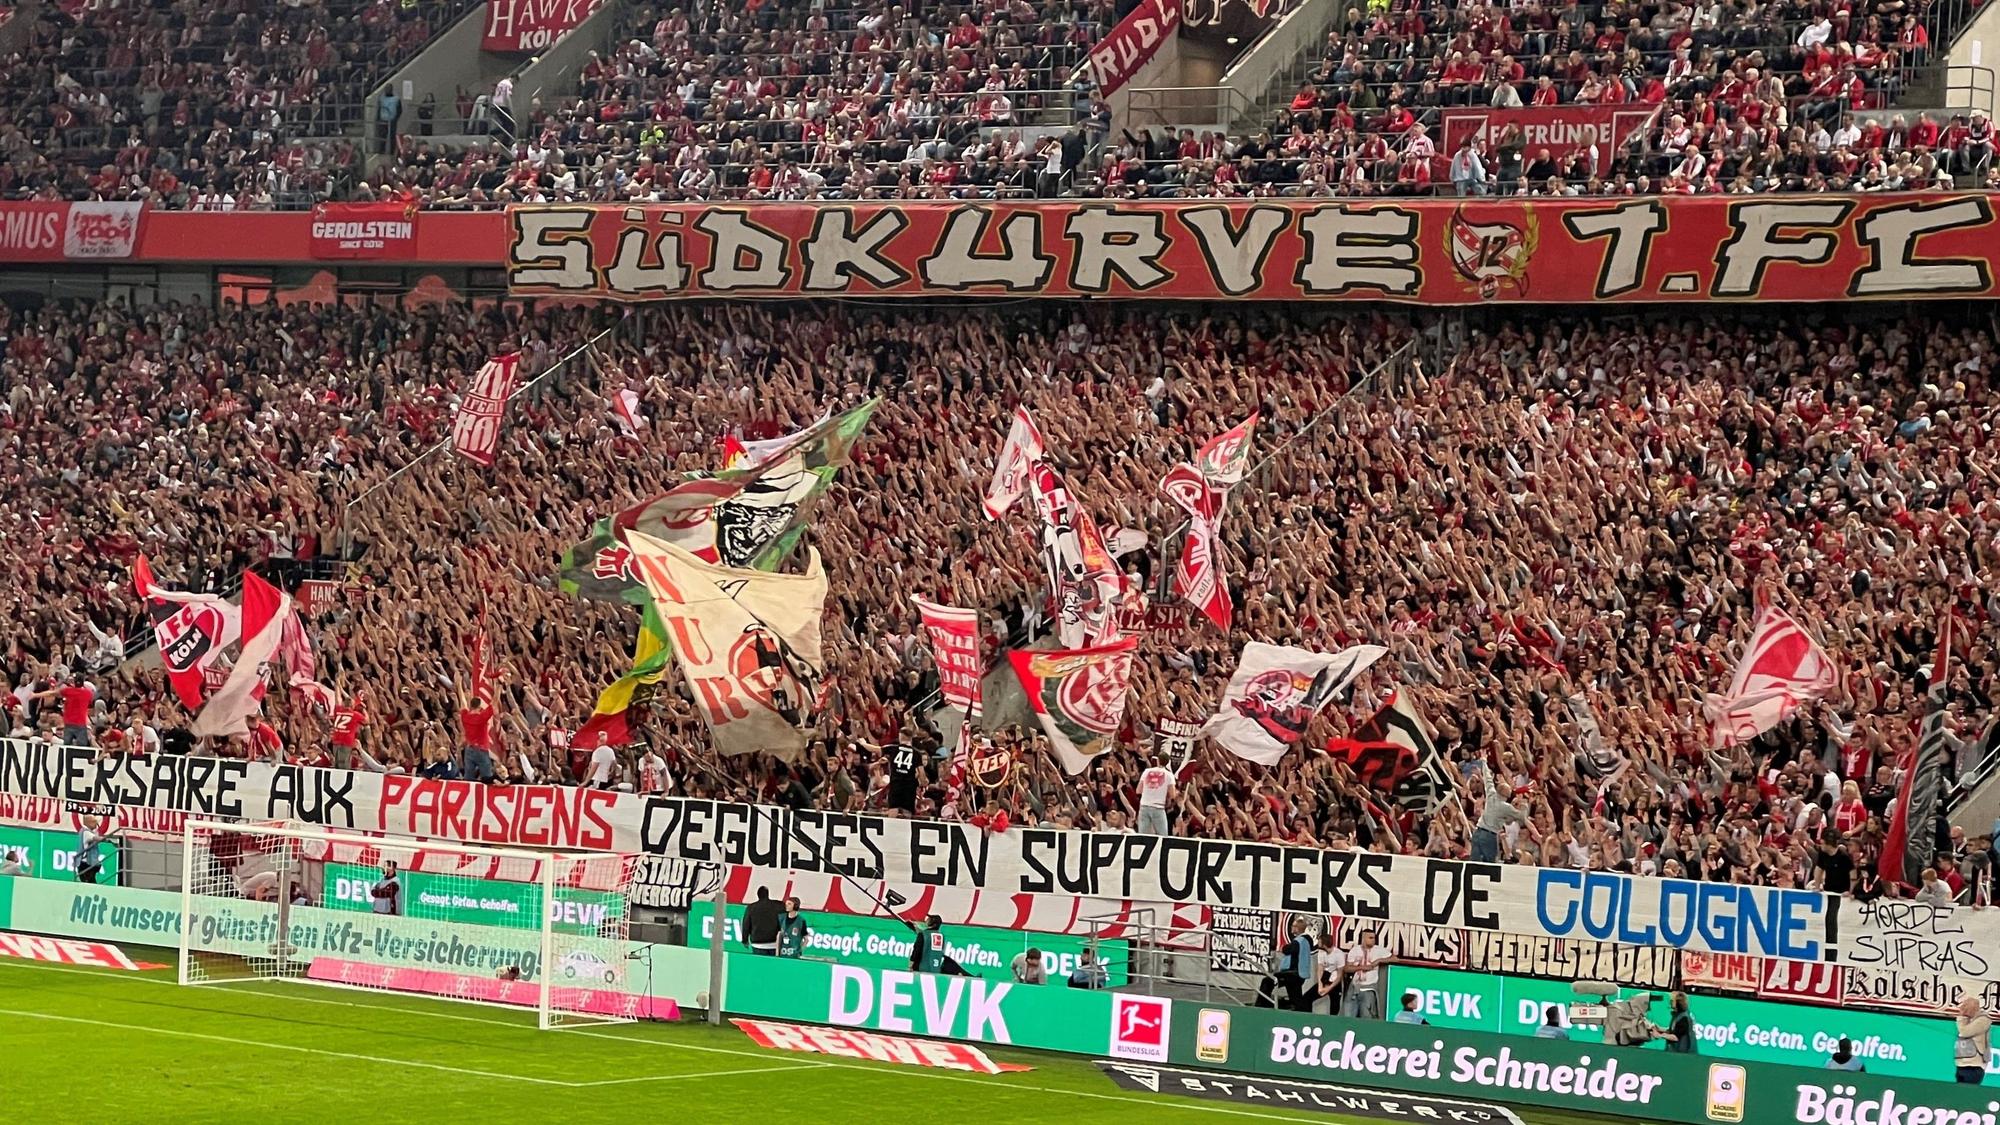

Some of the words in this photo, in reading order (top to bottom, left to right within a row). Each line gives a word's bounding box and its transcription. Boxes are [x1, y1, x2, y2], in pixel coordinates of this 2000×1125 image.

[0, 211, 59, 249] MUS
[312, 221, 412, 239] GEROLSTEIN
[512, 203, 1421, 297] SÜDKURVE
[1478, 235, 1508, 267] 12
[169, 618, 202, 666] KÖLN
[334, 714, 352, 729] 12
[894, 751, 913, 770] 44
[0, 792, 67, 824] STADT
[267, 766, 353, 829] AUX
[378, 773, 618, 850] PARISIENS
[641, 797, 884, 880] DEGUISES
[910, 820, 989, 888] EN
[1020, 829, 1393, 919] SUPPORTERS
[1424, 859, 1502, 930] DE
[1536, 868, 1842, 962] COLOGNE!
[634, 855, 698, 888] STADT
[336, 878, 377, 904] DEV
[630, 882, 692, 908] VERBOT
[70, 894, 107, 925] Mit
[201, 908, 318, 951] günstien
[1859, 896, 1963, 934] HORDE
[0, 935, 111, 967] WE
[803, 927, 863, 957] Gesagt.
[1339, 917, 1461, 964] COONIACS
[1470, 930, 1674, 988] VEEDELSRADAU
[1848, 934, 1990, 977] SUPRAS
[829, 964, 1014, 1044] DEVK
[1845, 966, 1964, 1009] Kölsche
[755, 1022, 975, 1073] REWE
[1117, 1045, 1161, 1057] BUNDESLIGA
[1691, 1021, 1740, 1047] sagt.
[1744, 1023, 1808, 1051] Getan.
[1812, 1030, 1907, 1062] Geolfen.
[1270, 1025, 1443, 1080] Bäckerei
[1450, 1046, 1663, 1104] Schneider
